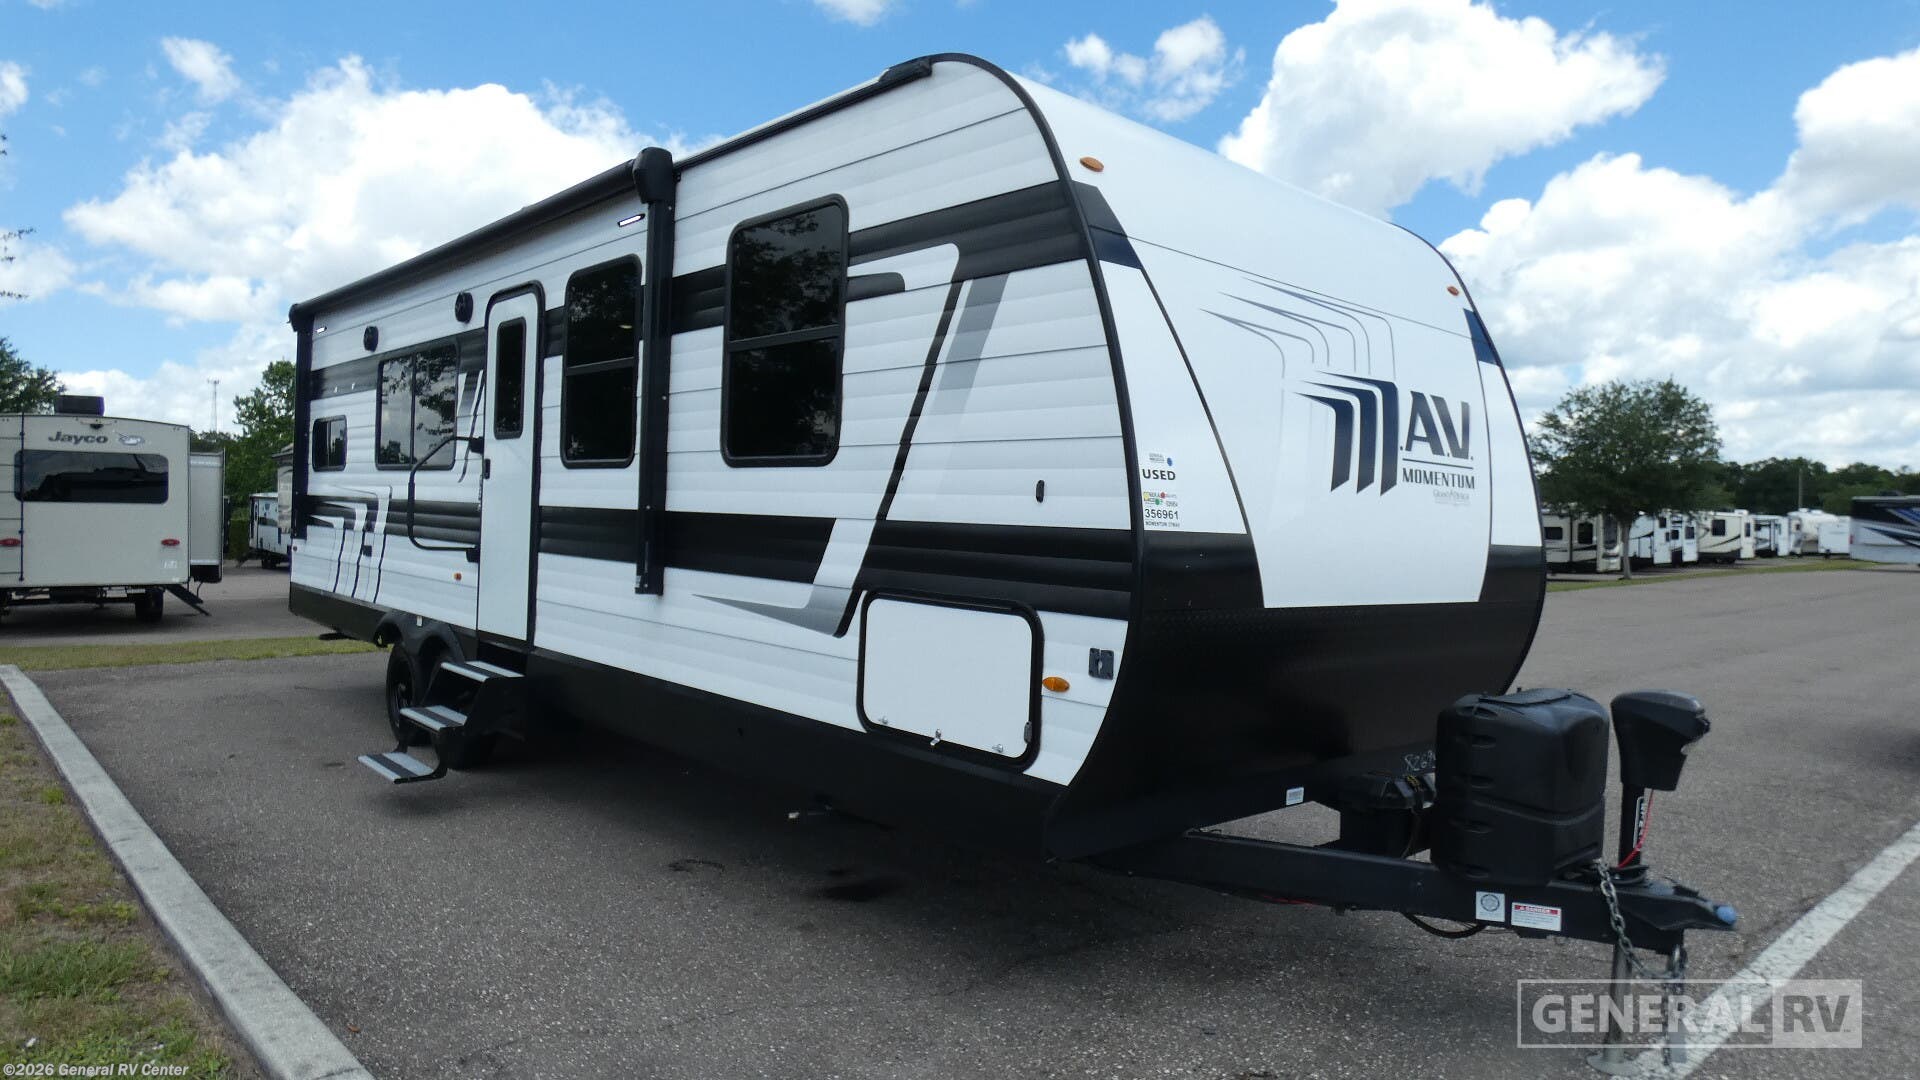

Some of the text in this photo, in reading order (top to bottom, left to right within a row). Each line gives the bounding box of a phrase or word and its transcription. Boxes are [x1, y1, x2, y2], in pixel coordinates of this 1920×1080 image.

[48, 431, 109, 445] Jayco
[1142, 468, 1176, 481] USED
[1402, 467, 1475, 489] MOMENTUM
[1145, 508, 1179, 520] 356961
